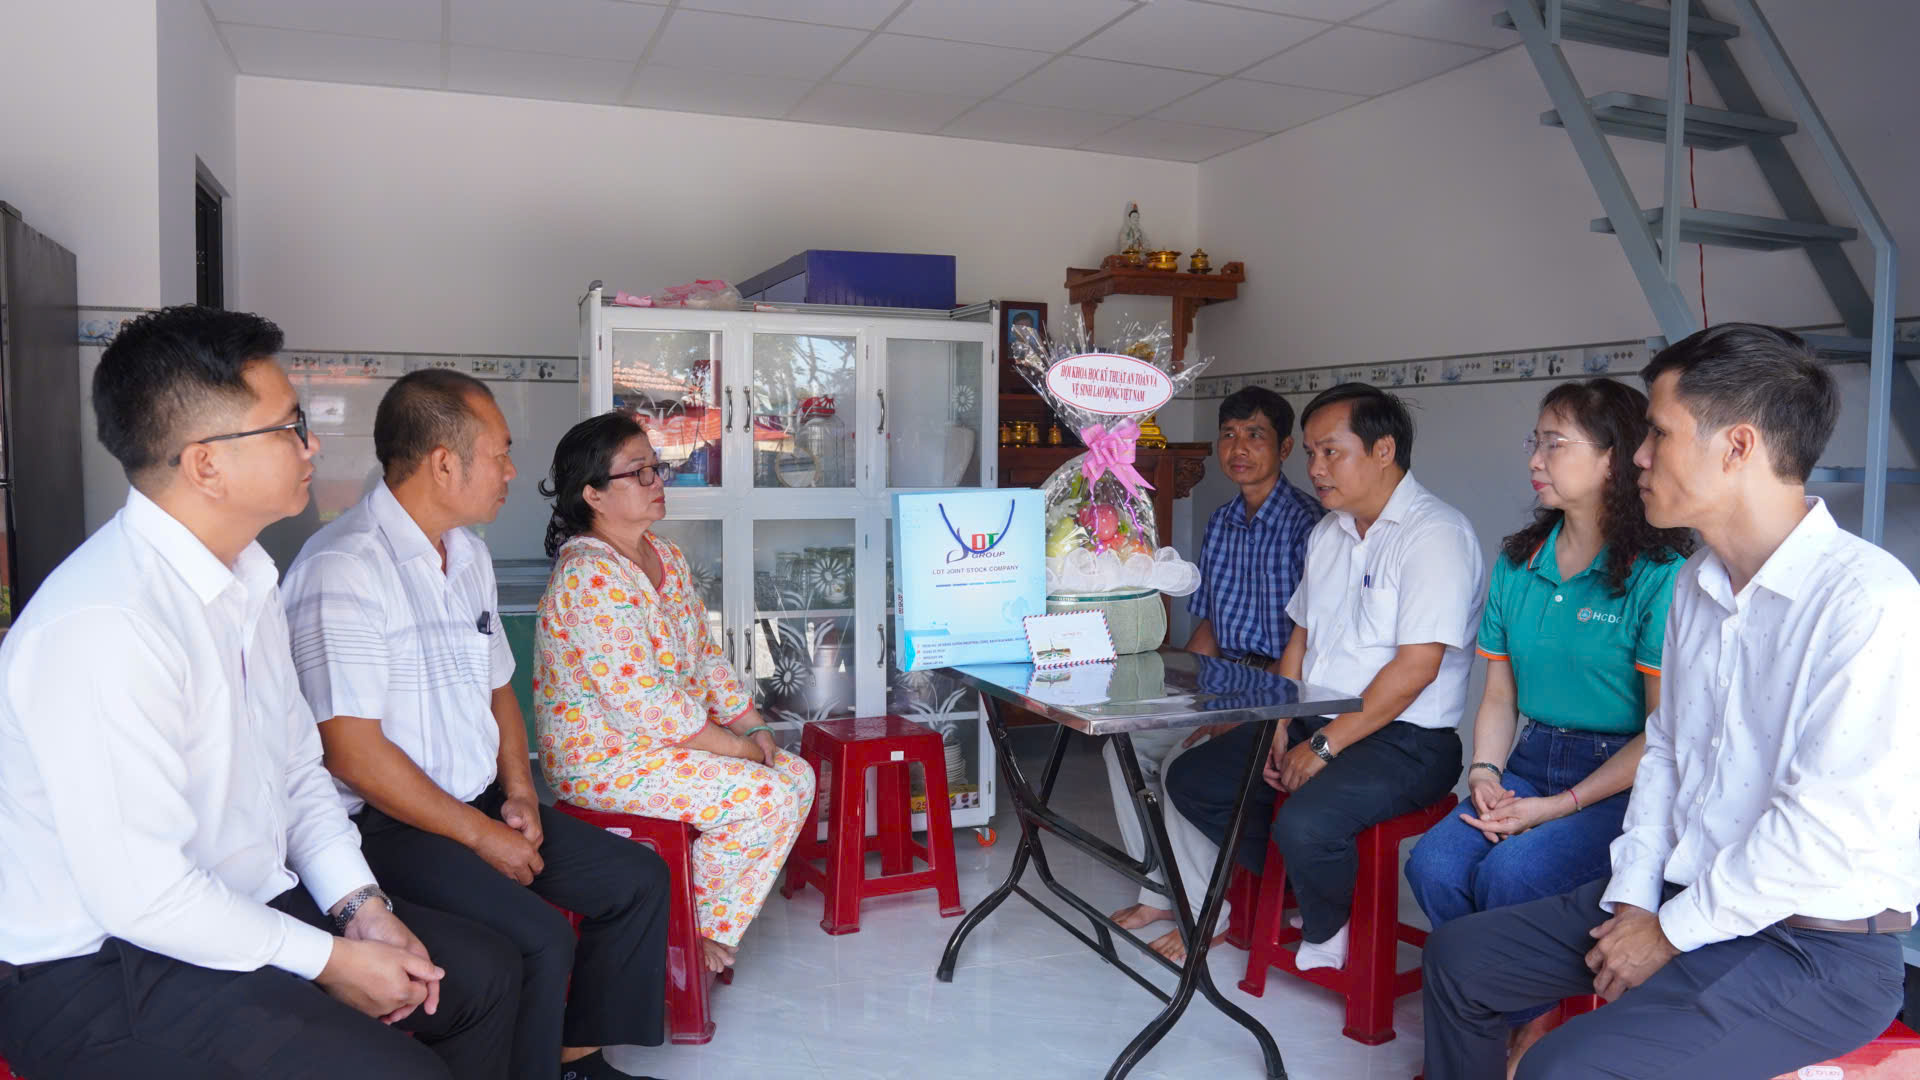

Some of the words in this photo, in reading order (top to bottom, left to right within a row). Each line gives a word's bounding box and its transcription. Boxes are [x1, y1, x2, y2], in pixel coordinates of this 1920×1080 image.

[1071, 365, 1087, 379] KHOA
[1088, 367, 1100, 383] HỌC
[1128, 372, 1135, 384] AN
[1080, 383, 1092, 396] SINH
[1092, 384, 1104, 397] LAO
[1133, 389, 1145, 402] NAM
[972, 551, 1006, 559] GROUP
[988, 564, 1019, 572] COMPANY
